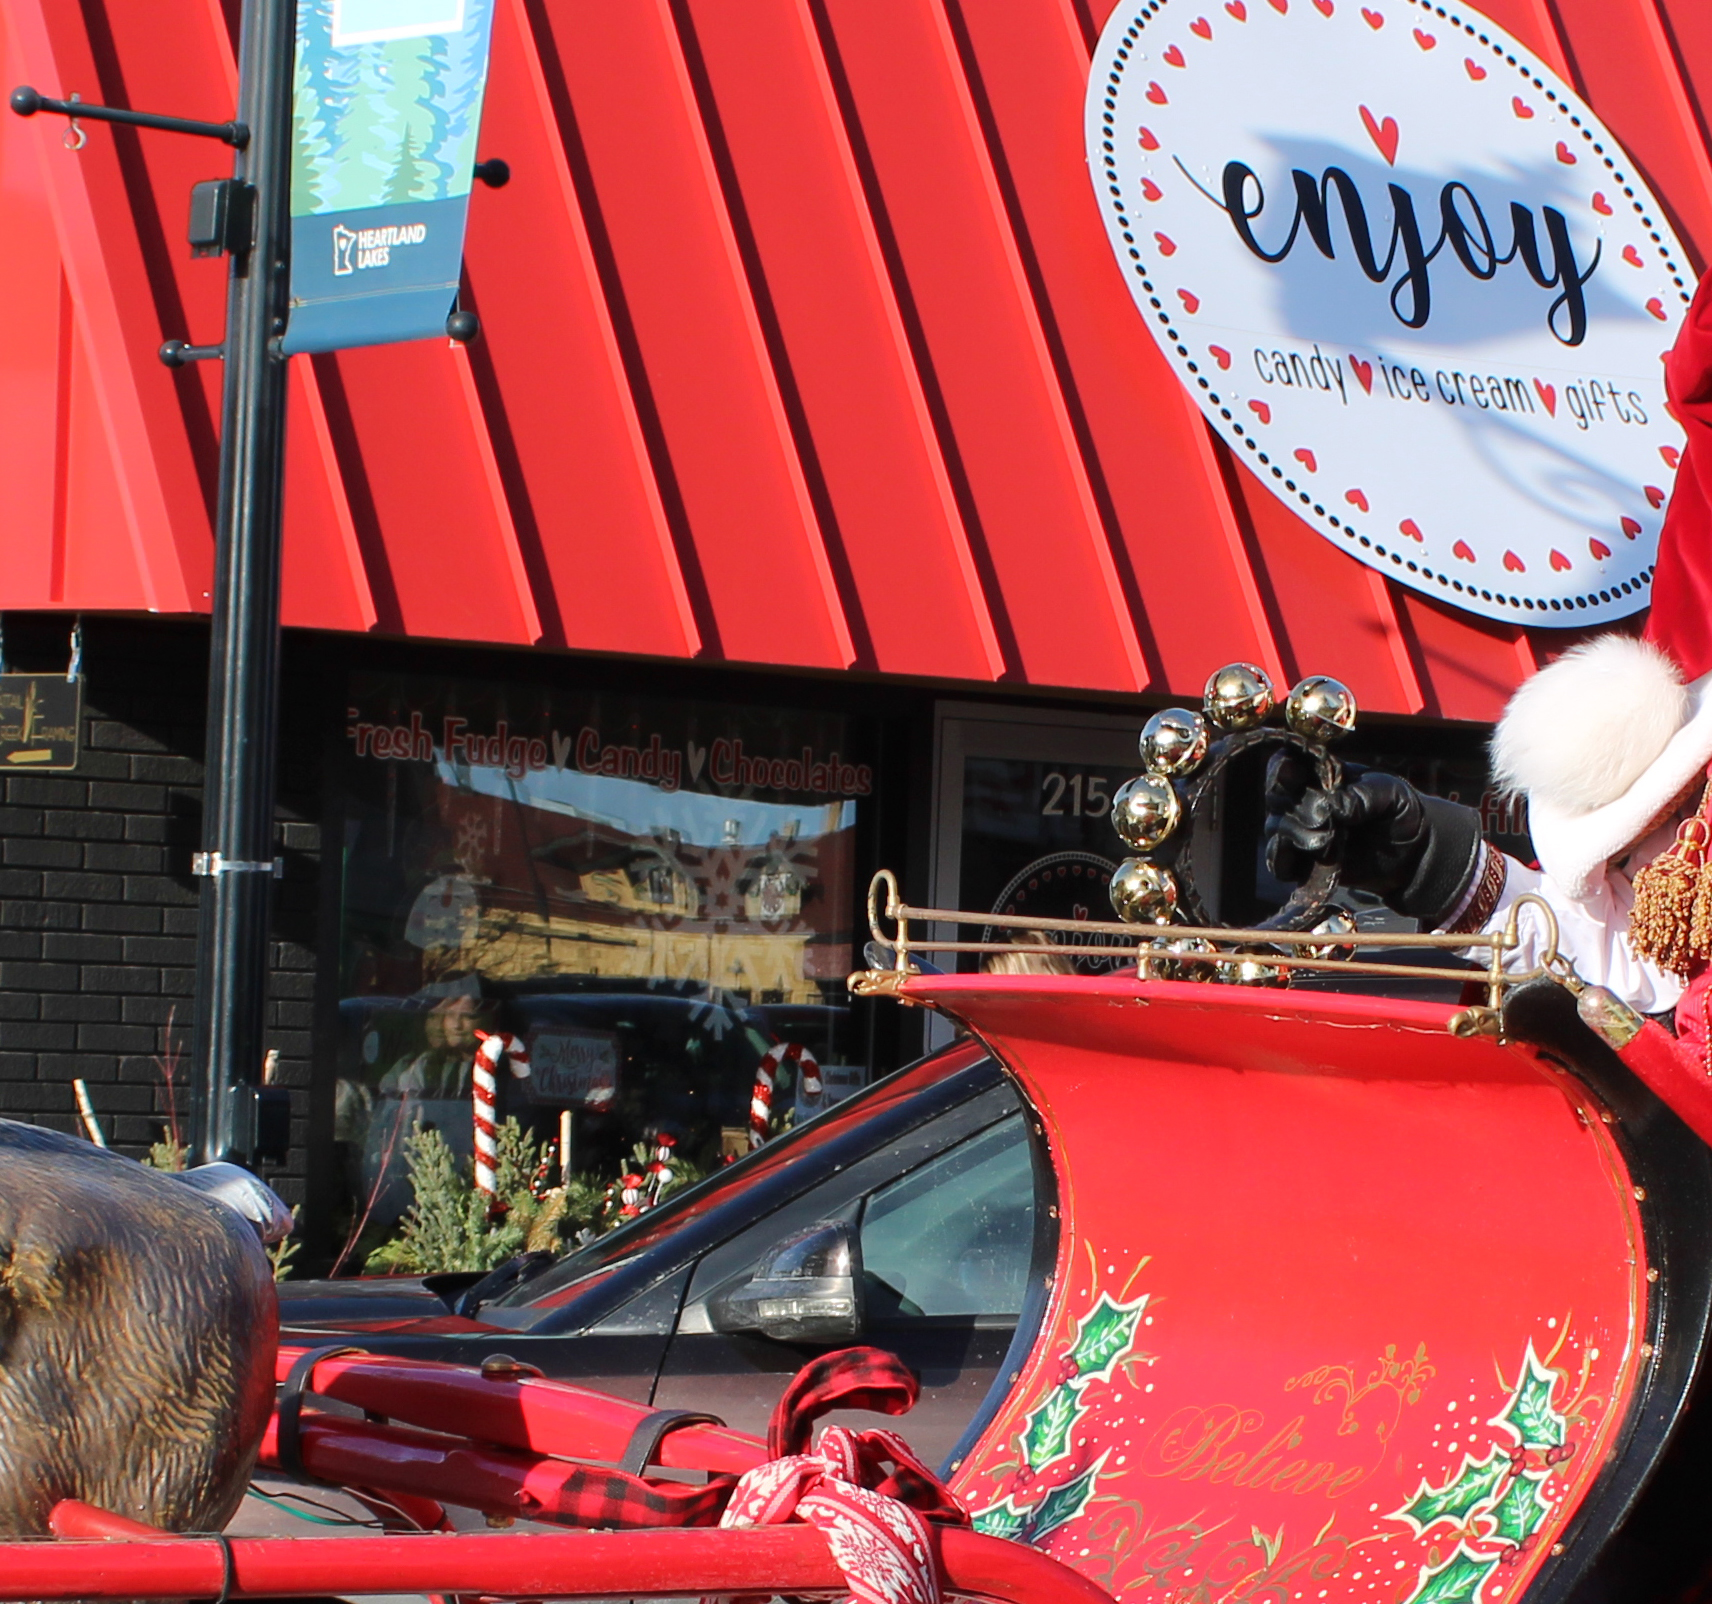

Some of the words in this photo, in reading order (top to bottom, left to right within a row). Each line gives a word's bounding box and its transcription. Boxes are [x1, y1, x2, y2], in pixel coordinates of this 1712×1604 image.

[357, 223, 427, 249] HEARTLAND
[357, 246, 390, 270] LAKES
[1173, 154, 1602, 347] enjoy
[1254, 343, 1348, 406] candy
[1378, 355, 1431, 402] ice
[1435, 367, 1536, 415] cream
[1564, 379, 1649, 431] gifts
[444, 716, 548, 780] Fudge
[575, 726, 682, 793] Candy
[709, 737, 873, 796] Chocolates
[1042, 772, 1110, 818] 215
[1141, 1403, 1368, 1499] Believe
